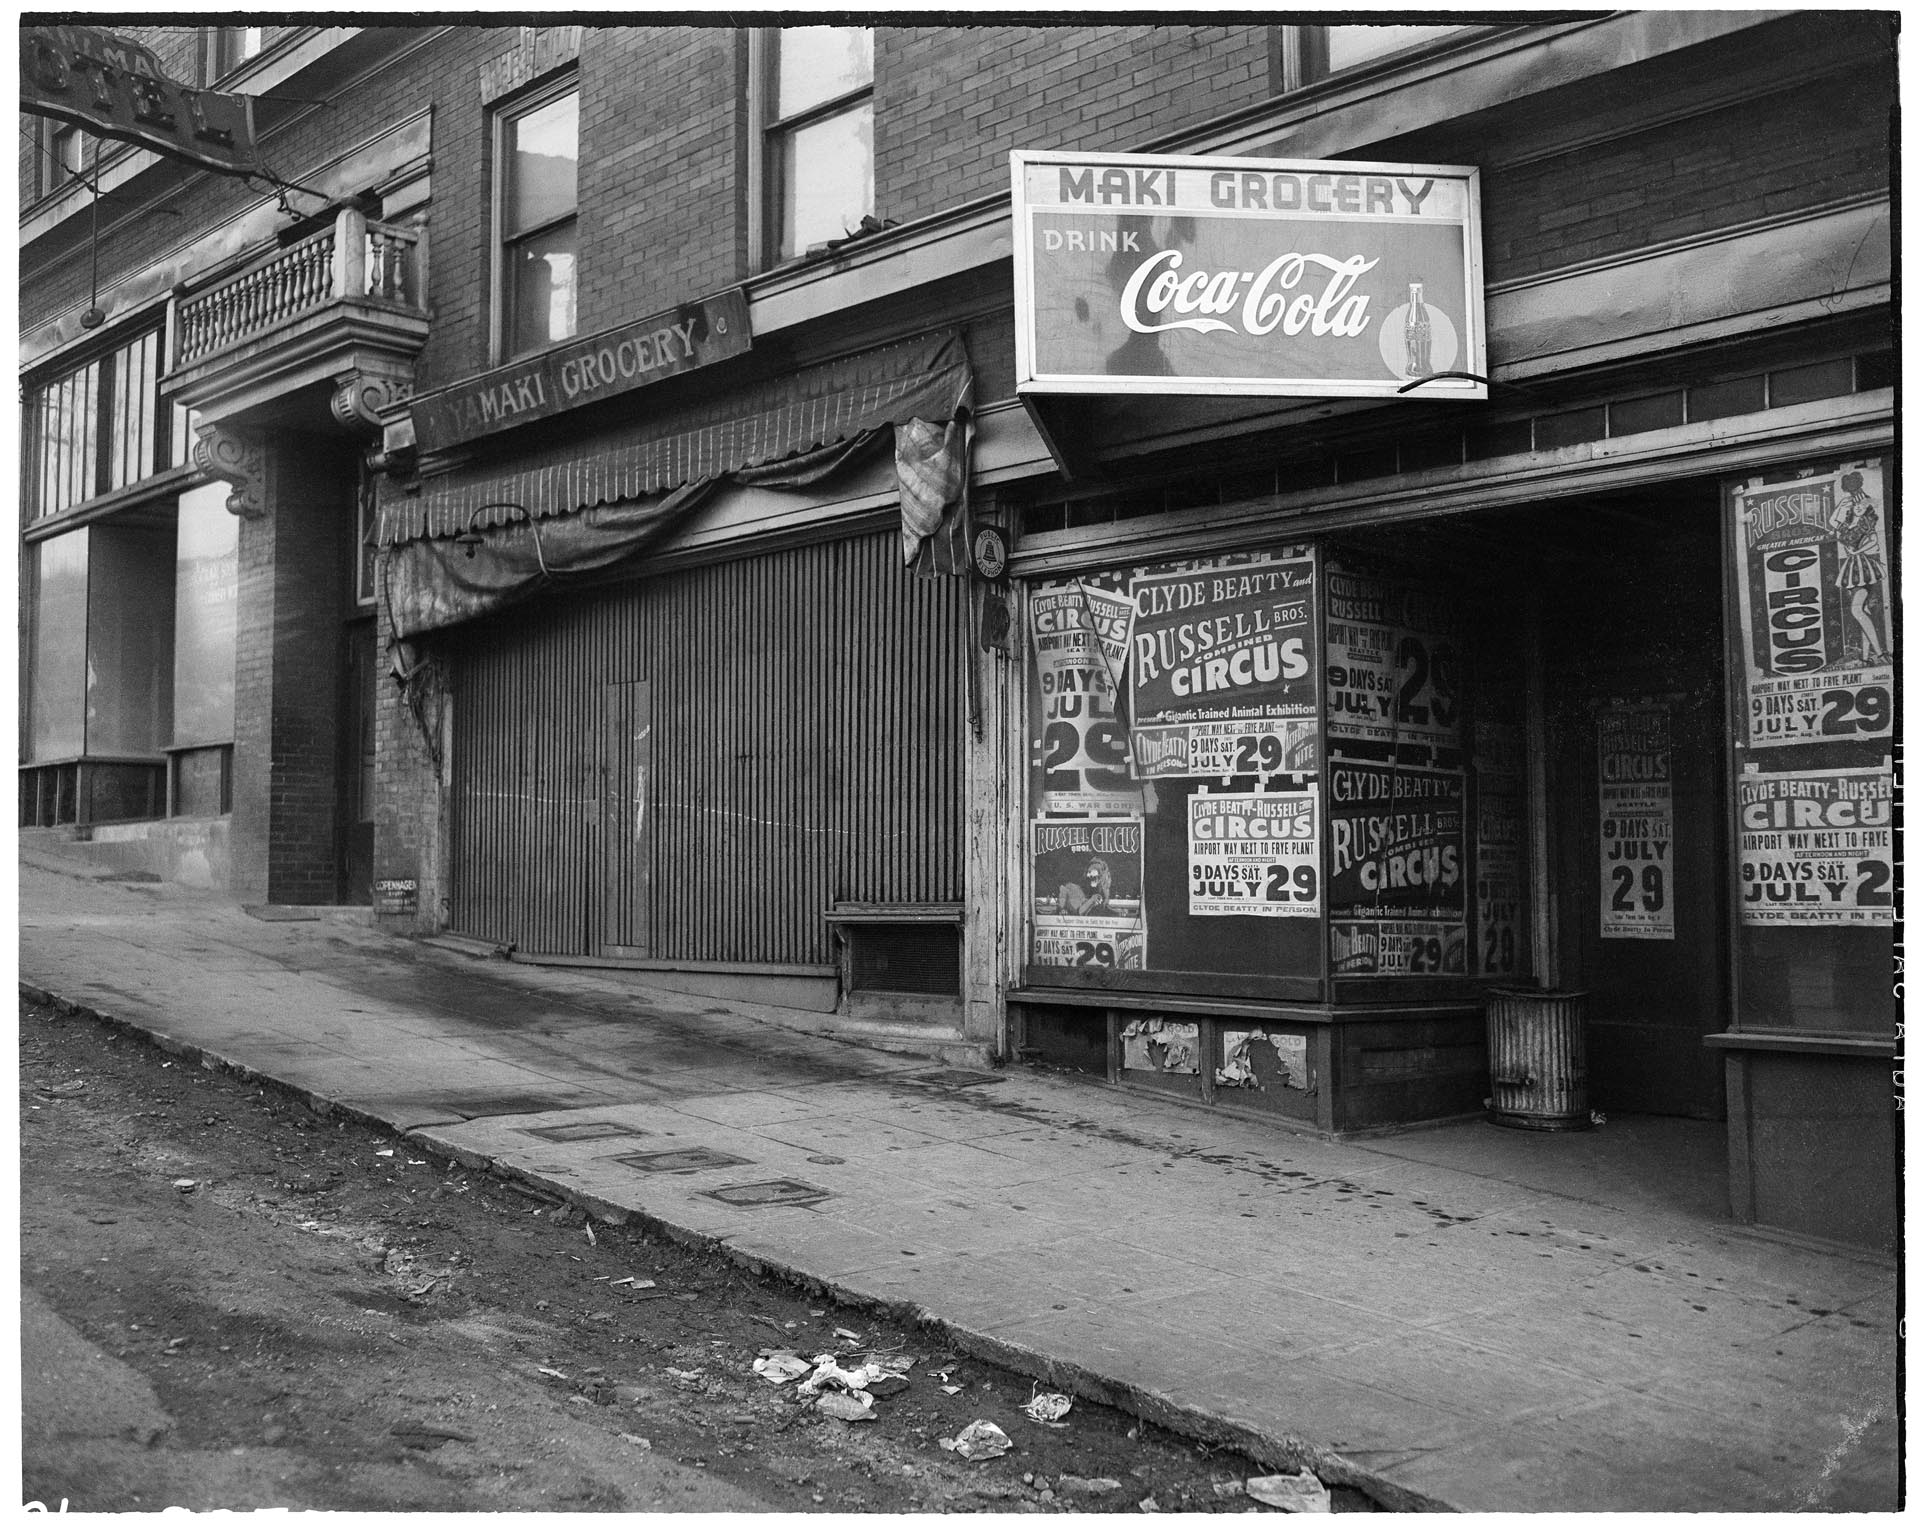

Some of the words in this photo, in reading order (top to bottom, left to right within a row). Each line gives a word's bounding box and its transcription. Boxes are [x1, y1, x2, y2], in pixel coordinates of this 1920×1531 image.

[1059, 167, 1176, 206] MAKI
[1210, 172, 1434, 214] GROCERY
[1042, 229, 1141, 253] DRINK
[1120, 249, 1380, 338] Coca-Cola
[562, 318, 697, 399] GROCERY
[452, 373, 547, 431] YAMAKI
[1748, 493, 1832, 549] RUSSELL
[1757, 541, 1787, 551] GREATER
[1788, 535, 1825, 546] AMERICAN
[1035, 597, 1057, 616] CLYDE
[1057, 594, 1084, 609] BEATTY
[1136, 584, 1206, 619] CLYDE
[1211, 571, 1293, 602] BEATTY
[1292, 572, 1313, 588] and
[1331, 598, 1381, 620] RUSSELL
[1766, 549, 1824, 673] CIRCUS
[1136, 609, 1271, 688] RUSSELL
[1273, 606, 1308, 624] BROS.
[1194, 634, 1273, 664] COMBINED
[1171, 637, 1309, 697] CIRCUS
[1328, 665, 1348, 688] 9
[1350, 668, 1375, 690] DAYS
[1042, 672, 1056, 695] 9
[1777, 681, 1791, 691] WAY
[1794, 678, 1809, 690] NEXT
[1812, 677, 1821, 688] TO
[1823, 675, 1840, 687] FRYE
[1842, 673, 1862, 685] PLANT
[1165, 709, 1197, 724] Gigantic
[1197, 707, 1229, 720] Trained
[1231, 705, 1263, 718] Animal
[1266, 703, 1316, 716] Exhibition
[1329, 691, 1392, 717] JULY
[1752, 698, 1763, 717] 9
[1766, 694, 1794, 716] DAYS
[1797, 698, 1820, 713] SAT.
[1821, 686, 1890, 736] 29
[1331, 725, 1361, 735] CLYDE
[1752, 714, 1818, 735] JULY
[1191, 739, 1199, 753] 9
[1200, 737, 1219, 753] DAYS
[1220, 741, 1236, 753] SAT.
[1236, 735, 1283, 772] 29
[1294, 744, 1314, 769] NITE
[1191, 754, 1234, 768] JULY
[1603, 753, 1667, 780] CIRCUS
[1333, 769, 1390, 801] CLYDE
[1394, 775, 1450, 798] BEATTY
[1741, 782, 1776, 805] CLYDE
[1193, 801, 1217, 819] CLYDE
[1743, 800, 1890, 829] CIRCU
[1195, 815, 1311, 839] CIRCUS
[1602, 819, 1617, 838] 9
[1620, 819, 1649, 838] DAYS
[1035, 826, 1090, 856] RUSSELL
[1091, 826, 1140, 853] CIRCUS
[1193, 842, 1221, 855] AIRPORT
[1224, 842, 1238, 855] WAY
[1240, 842, 1257, 855] NEXT
[1260, 842, 1269, 855] TO
[1271, 842, 1288, 855] FRYE
[1291, 841, 1314, 855] PLANT
[1331, 813, 1434, 877] RUSSELL
[1607, 841, 1668, 860] JULY
[1743, 834, 1782, 850] AIRPORT
[1788, 833, 1809, 849] WAY
[1814, 832, 1840, 849] NEXT
[1845, 832, 1857, 848] TO
[1863, 830, 1889, 847] FRYE
[1193, 864, 1202, 880] 9
[1204, 864, 1239, 880] DAYS
[1241, 867, 1262, 881] SAT.
[1360, 845, 1460, 892] CIRCUS
[1742, 862, 1755, 882] 9
[1759, 861, 1813, 882] DAYS
[1817, 864, 1849, 881] SAT.
[375, 880, 417, 892] COPENHAGEN
[1193, 881, 1262, 897] JULY
[1266, 864, 1317, 902] 29
[1611, 865, 1664, 912] 29
[1745, 882, 1848, 902] JULY
[1857, 859, 1892, 906] 2
[1193, 904, 1220, 912] CLYDE
[1223, 904, 1258, 912] BEATTY
[1276, 905, 1317, 914] PERSON
[1744, 912, 1785, 920] CLYDE
[1790, 912, 1843, 920] BEATTY
[1850, 912, 1864, 920] IN
[1036, 940, 1042, 953] 9
[1043, 940, 1060, 954] DAYS
[1062, 944, 1077, 956] SAT.
[1076, 941, 1115, 968] 29
[1380, 939, 1388, 953] 9
[1411, 937, 1442, 973] 29
[1380, 954, 1411, 967] JULY
